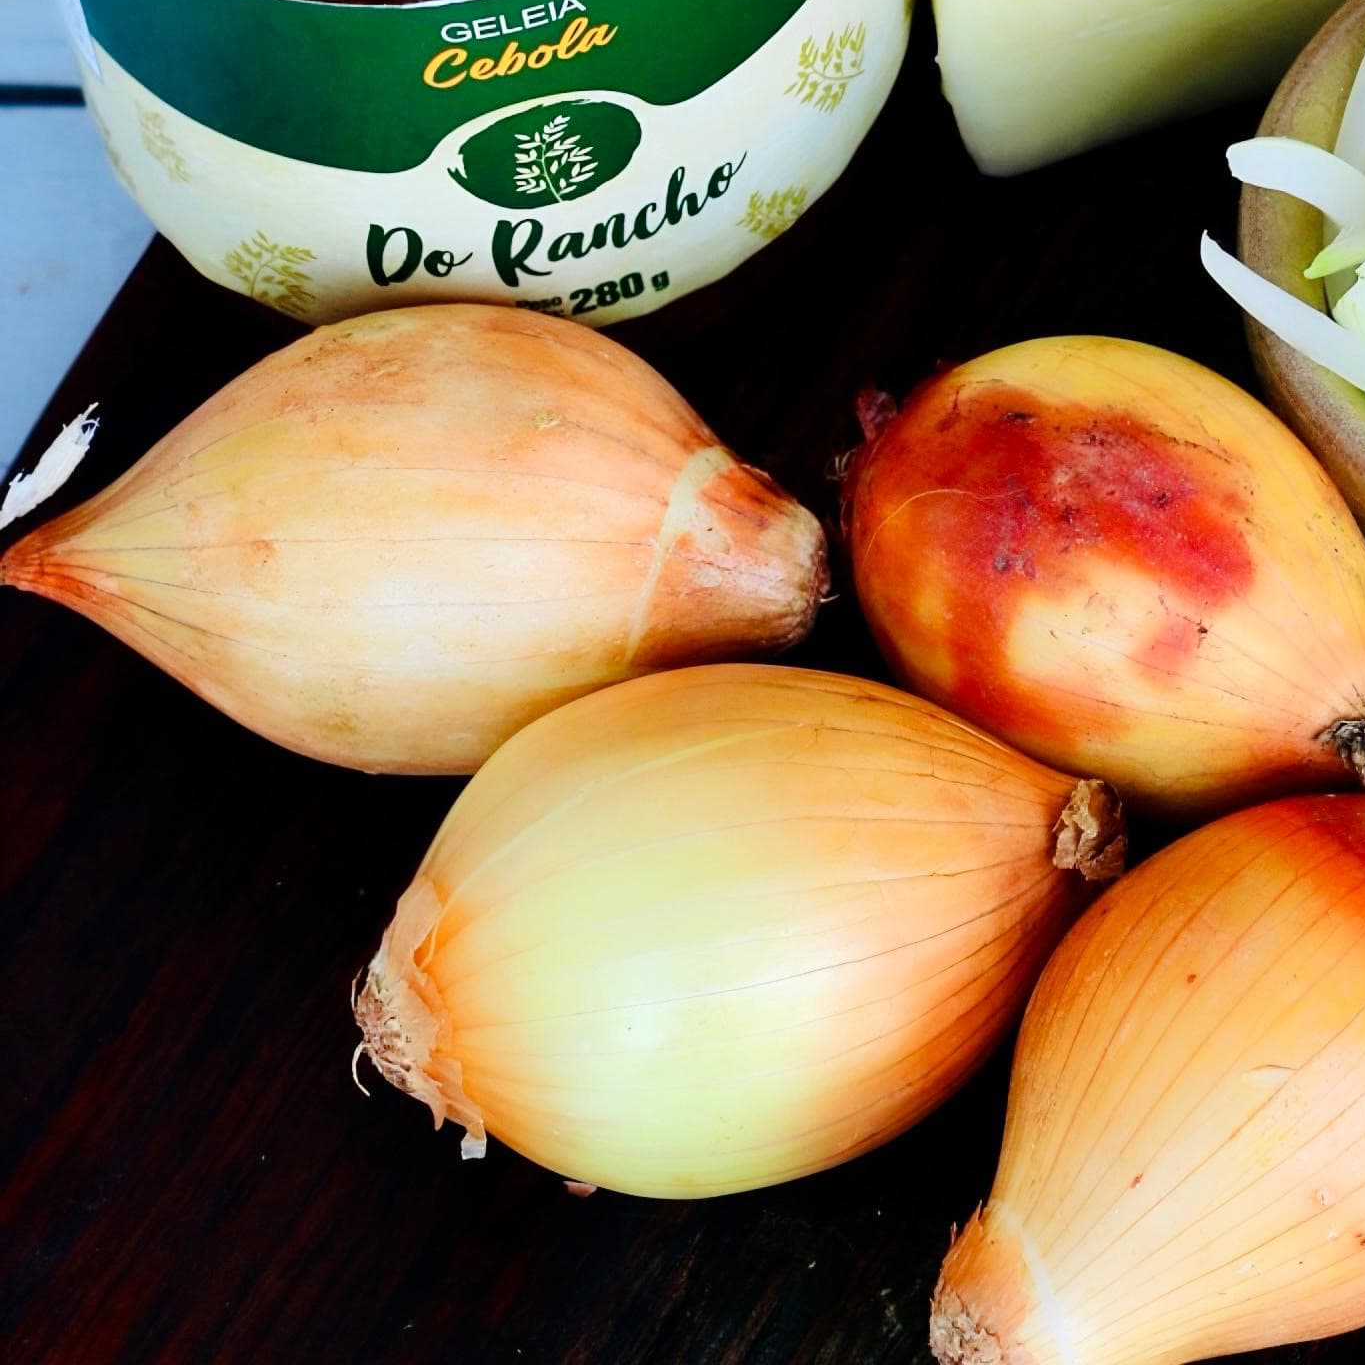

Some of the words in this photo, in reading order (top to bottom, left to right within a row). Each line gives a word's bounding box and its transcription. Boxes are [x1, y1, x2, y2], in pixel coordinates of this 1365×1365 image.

[422, 16, 618, 89] Cebola
[366, 223, 473, 287] Do
[491, 150, 748, 287] Rancho
[569, 271, 645, 316] 280
[651, 270, 670, 292] g
